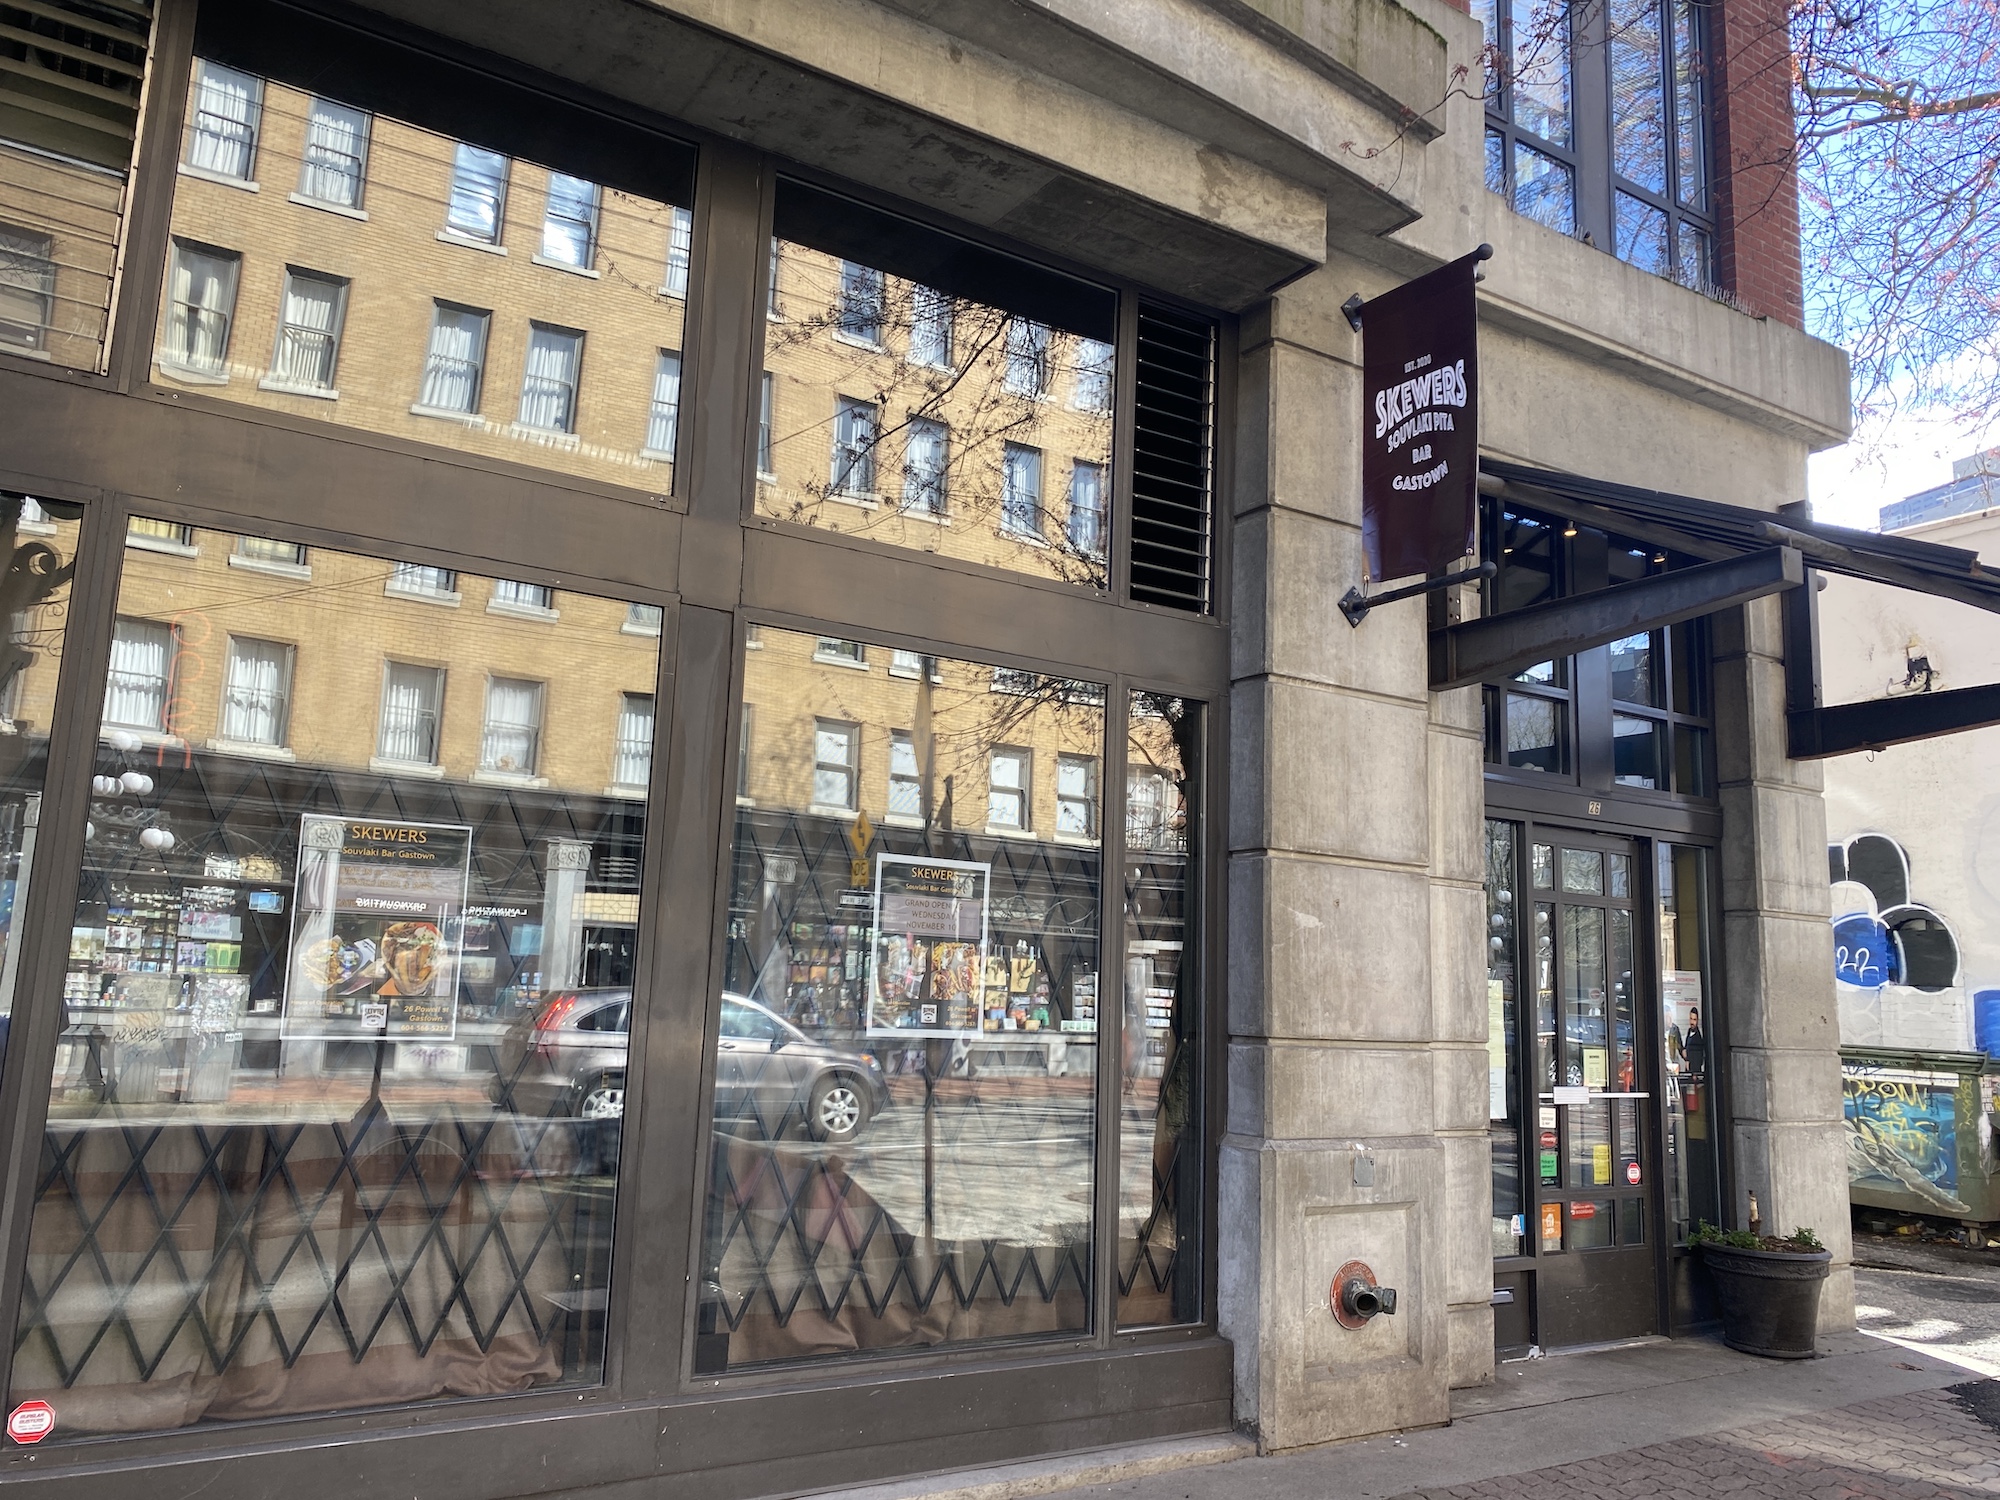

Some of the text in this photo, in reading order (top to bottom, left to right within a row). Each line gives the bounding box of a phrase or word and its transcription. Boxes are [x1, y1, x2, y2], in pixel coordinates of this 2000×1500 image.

[1375, 359, 1468, 440] SKEWERS
[1387, 411, 1455, 454] SOUVLAKI PITA
[1412, 444, 1433, 464] BAR
[1392, 459, 1449, 491] GASTOWN
[1589, 802, 1600, 814] 26
[351, 825, 428, 844] SKEWERS
[342, 846, 435, 860] Souvlaki Bar Gastown
[911, 867, 959, 881] SKEWERS
[905, 899, 964, 911] GRAND OPENG
[906, 920, 945, 931] NOVEMBER
[1836, 945, 1880, 982] 22
[403, 1005, 414, 1013] 26
[409, 1014, 443, 1022] Gastown
